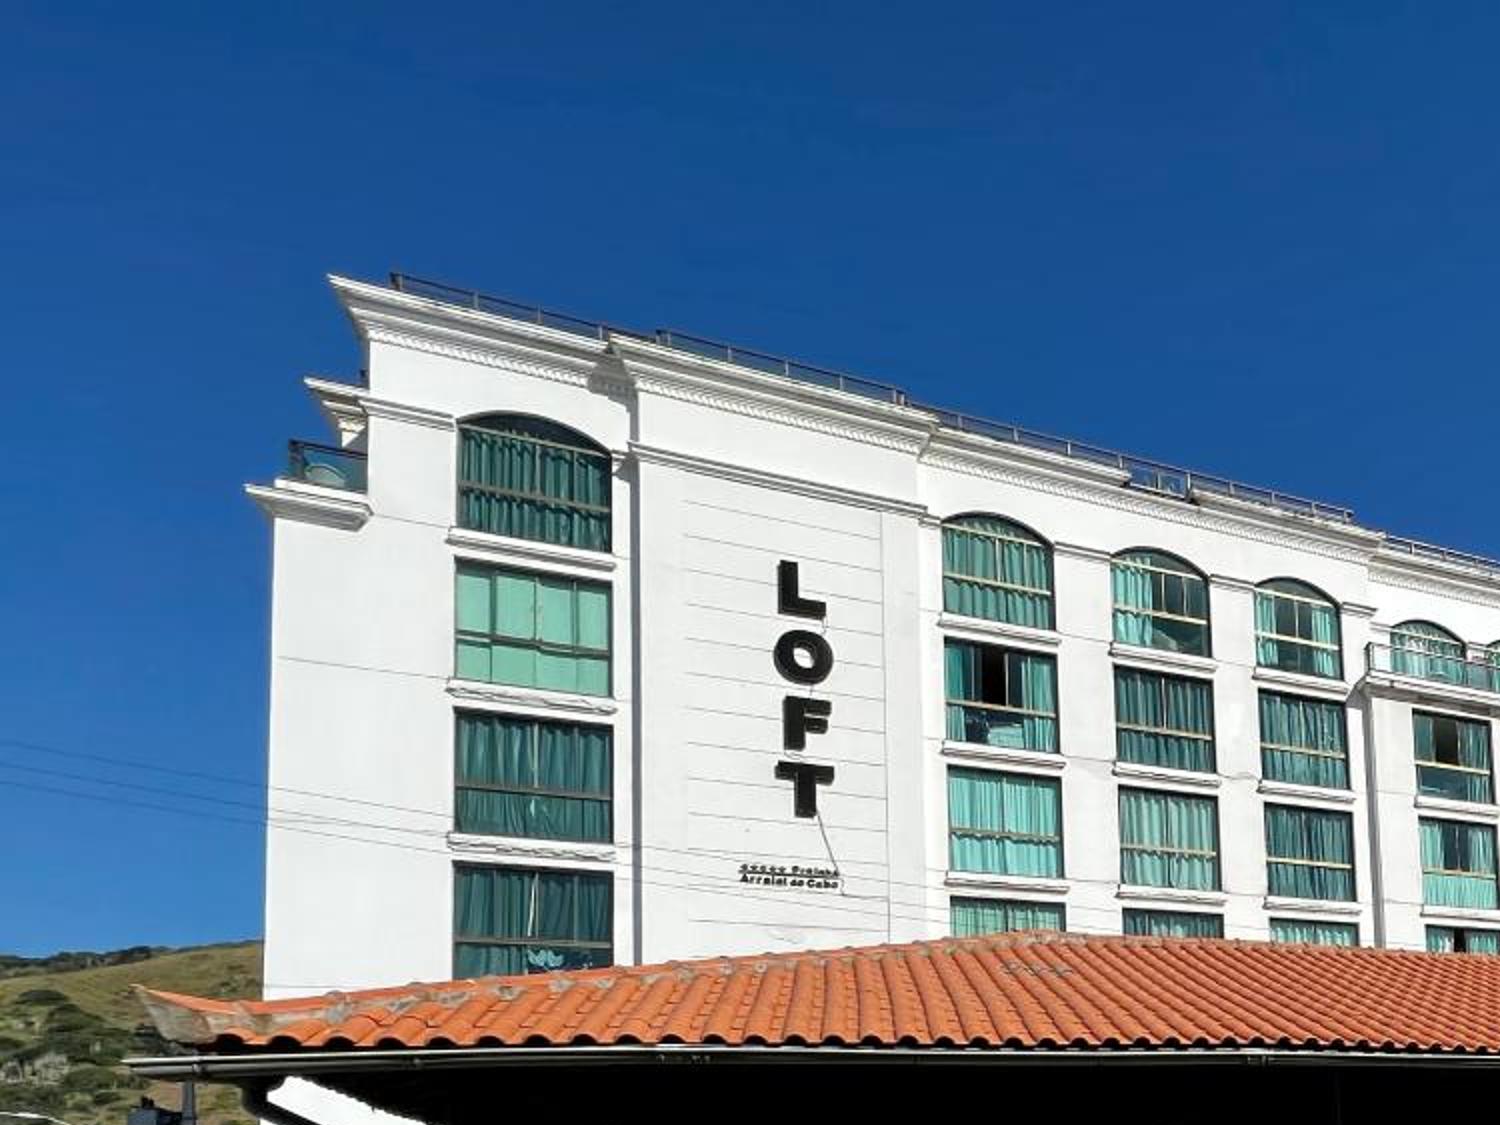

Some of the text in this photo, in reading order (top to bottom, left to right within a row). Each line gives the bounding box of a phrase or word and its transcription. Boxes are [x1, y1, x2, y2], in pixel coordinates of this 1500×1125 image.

[774, 560, 834, 817] LOFT
[740, 873, 787, 886] Arraial
[806, 879, 838, 888] Cabo
